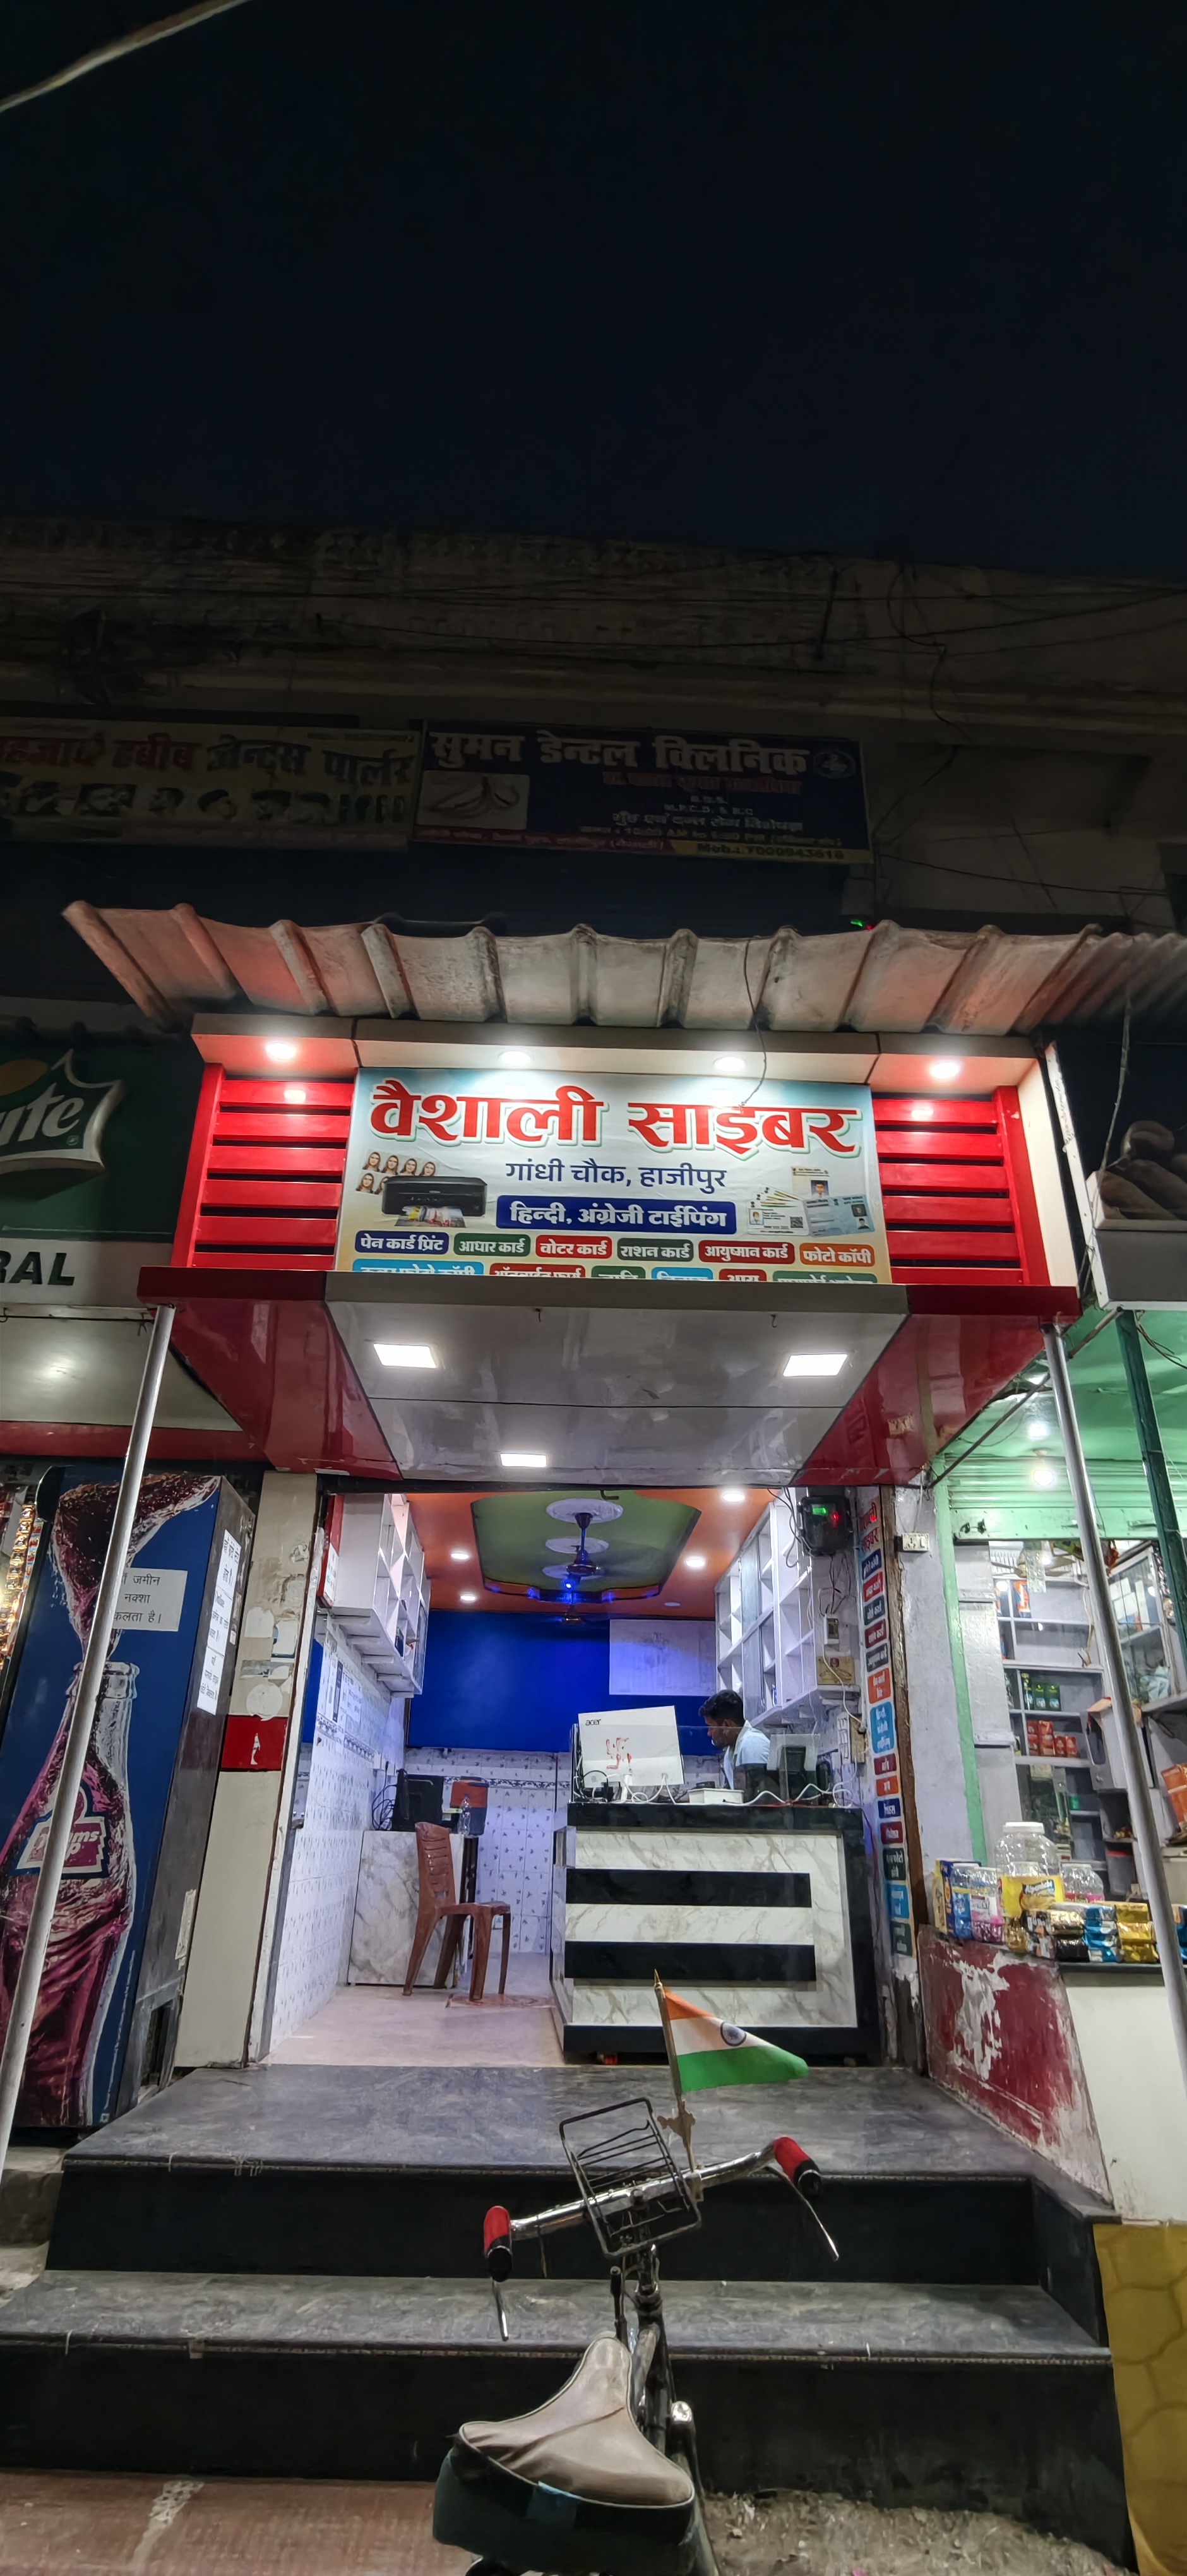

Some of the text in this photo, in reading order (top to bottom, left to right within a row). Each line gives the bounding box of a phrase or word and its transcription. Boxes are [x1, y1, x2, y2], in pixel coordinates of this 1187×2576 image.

[430, 730, 525, 769] सुमन
[370, 1079, 861, 1157] वैशाली साइबर
[506, 1158, 727, 1194] गांधी चौक, हाजीपुर
[509, 1200, 727, 1227] हिन्दी, अंग्रेजी टाईपिंग
[361, 1234, 444, 1251] पेन कार्ड प्रिंट
[458, 1238, 526, 1253] आधार कार्ड
[540, 1239, 608, 1255] वोटर कार्ड
[619, 1243, 691, 1258] राशन कार्ड
[705, 1244, 788, 1261] आयुष्मान कार्ड
[802, 1247, 871, 1264] फोटो कॉपी
[133, 1573, 160, 1585] जमीन
[124, 1594, 150, 1604] नक्शा
[114, 1611, 143, 1623] कलता
